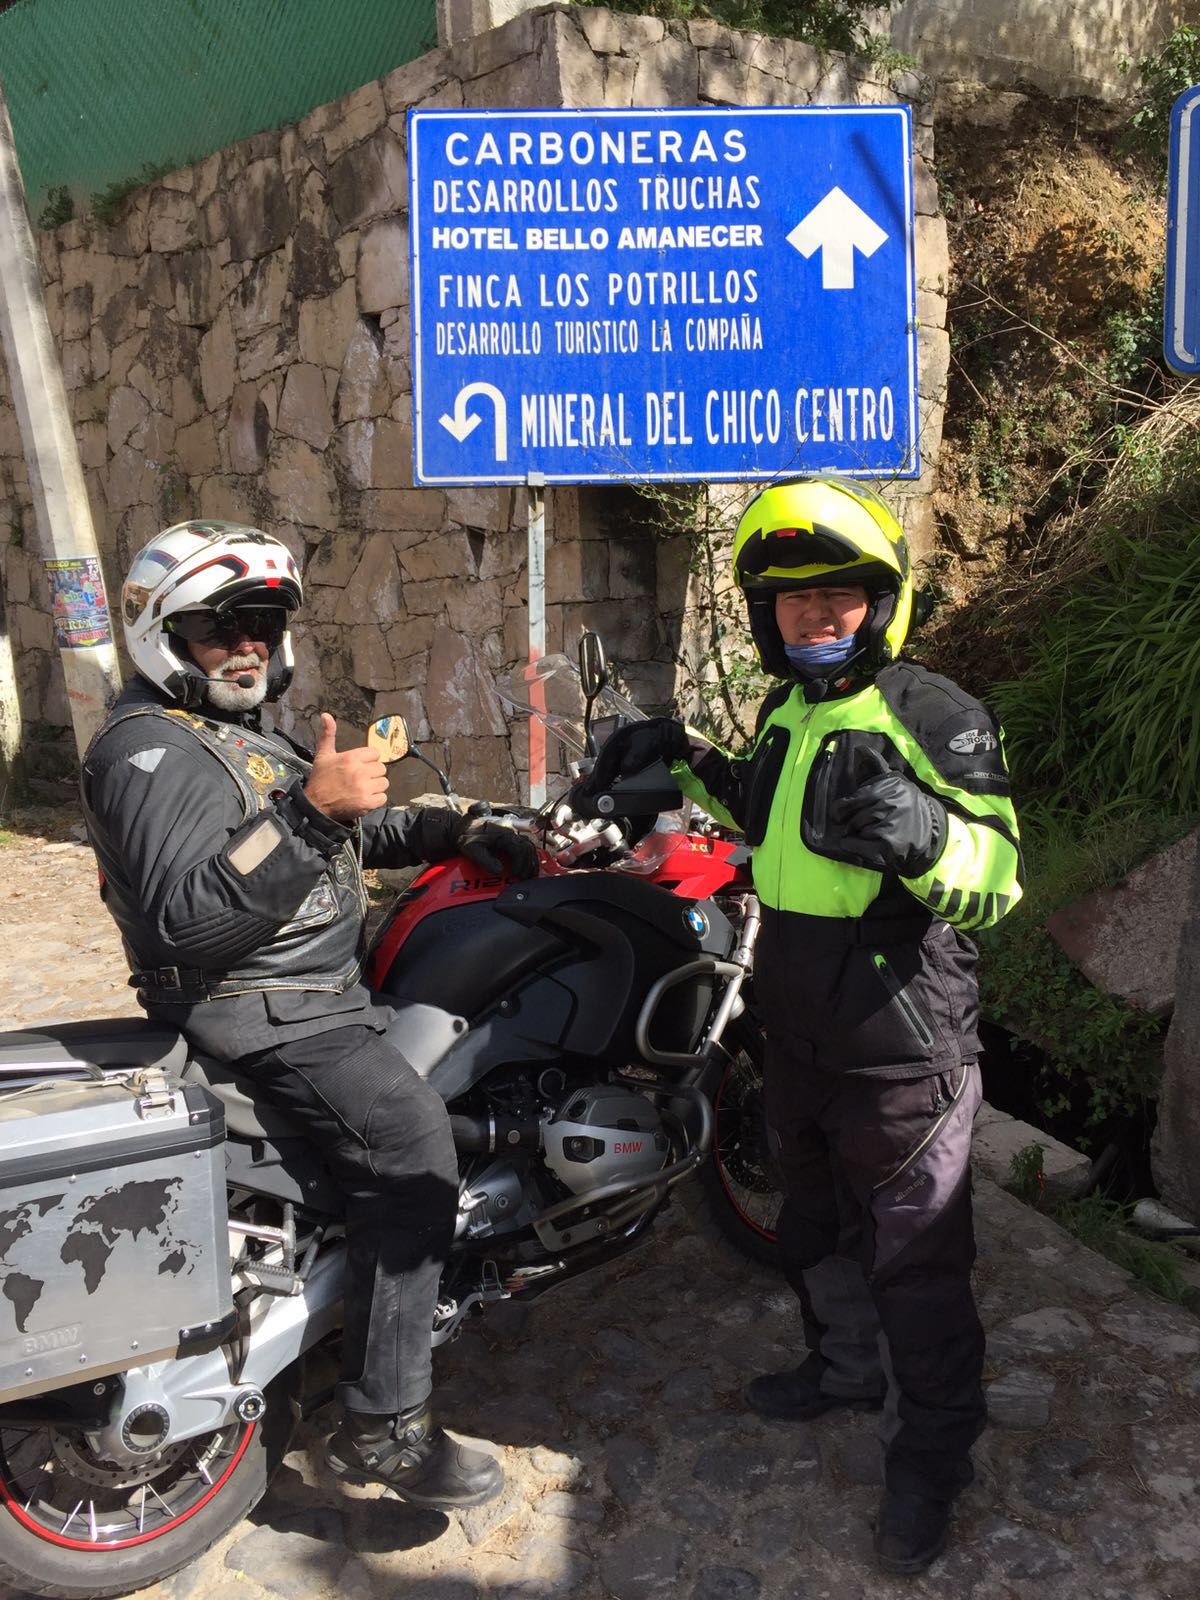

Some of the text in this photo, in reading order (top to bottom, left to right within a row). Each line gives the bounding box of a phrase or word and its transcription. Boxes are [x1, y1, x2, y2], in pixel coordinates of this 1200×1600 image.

[445, 129, 747, 166] CARBONERAS
[433, 175, 761, 214] DESARROLLOS TRUCHAS
[432, 224, 764, 251] HOTEL BELLO AMANECER
[439, 269, 758, 309] FINCA LOS POTRILLOS
[435, 313, 763, 356] DESARROLLO TURISTICO LA COMPAÑA
[521, 386, 895, 449] MINERAL DEL CHICO CENTRO
[614, 1142, 642, 1154] BMW
[23, 1327, 79, 1354] BMW
